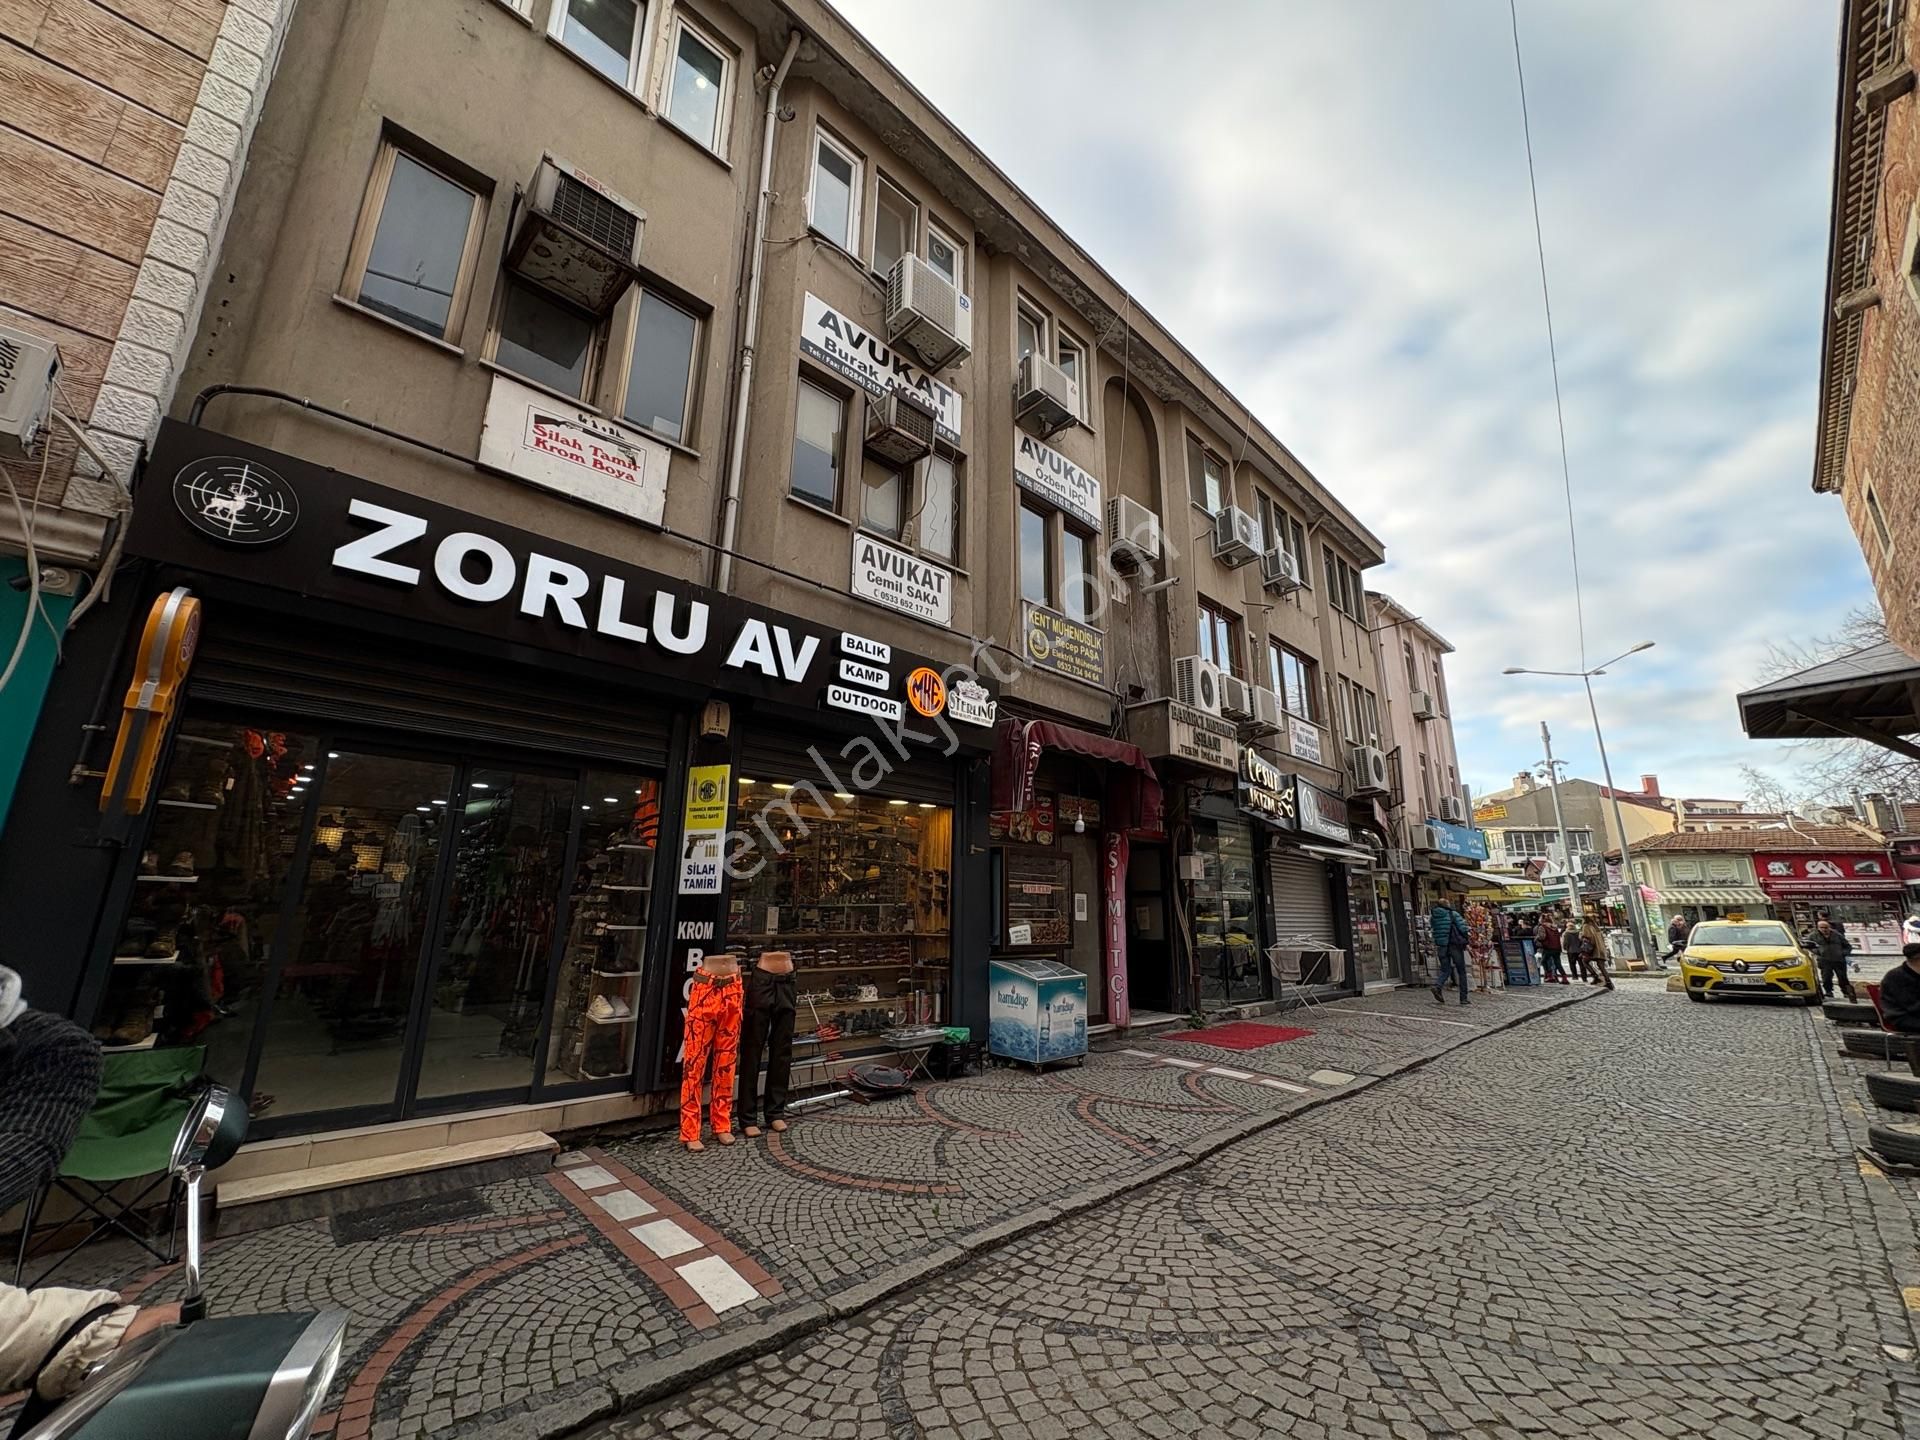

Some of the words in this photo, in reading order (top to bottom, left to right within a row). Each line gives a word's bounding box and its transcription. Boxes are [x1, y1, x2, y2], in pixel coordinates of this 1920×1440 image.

[818, 310, 952, 407] AVUKAT
[824, 336, 880, 382] Burak
[532, 423, 583, 451] Silah
[589, 444, 641, 472] Tamir
[534, 436, 585, 464] Krom
[592, 457, 636, 482] Boya
[1020, 436, 1097, 498] AVUKAT
[1035, 464, 1066, 494] Özben
[861, 544, 945, 593] AVUKAT
[331, 498, 709, 655] ZORLU
[722, 617, 820, 684] AV
[866, 570, 903, 593] Cemil
[906, 585, 939, 607] SAKA
[880, 591, 899, 605] 0533
[899, 598, 914, 610] 652
[915, 603, 924, 613] 17
[925, 607, 933, 616] 71
[846, 637, 886, 659] BALIK
[1028, 609, 1051, 629] KENT
[1052, 618, 1102, 651] MÜHENDİSLİK
[1055, 636, 1079, 654] Recep
[845, 664, 884, 684] KAMP
[912, 673, 941, 712] MKE
[831, 689, 897, 715] OUTDOOR
[949, 691, 993, 720] STERLING
[1248, 747, 1278, 791] Cesur
[683, 875, 717, 890] TAMİRİ
[686, 862, 716, 876] SİLAH
[677, 921, 714, 940] KROM
